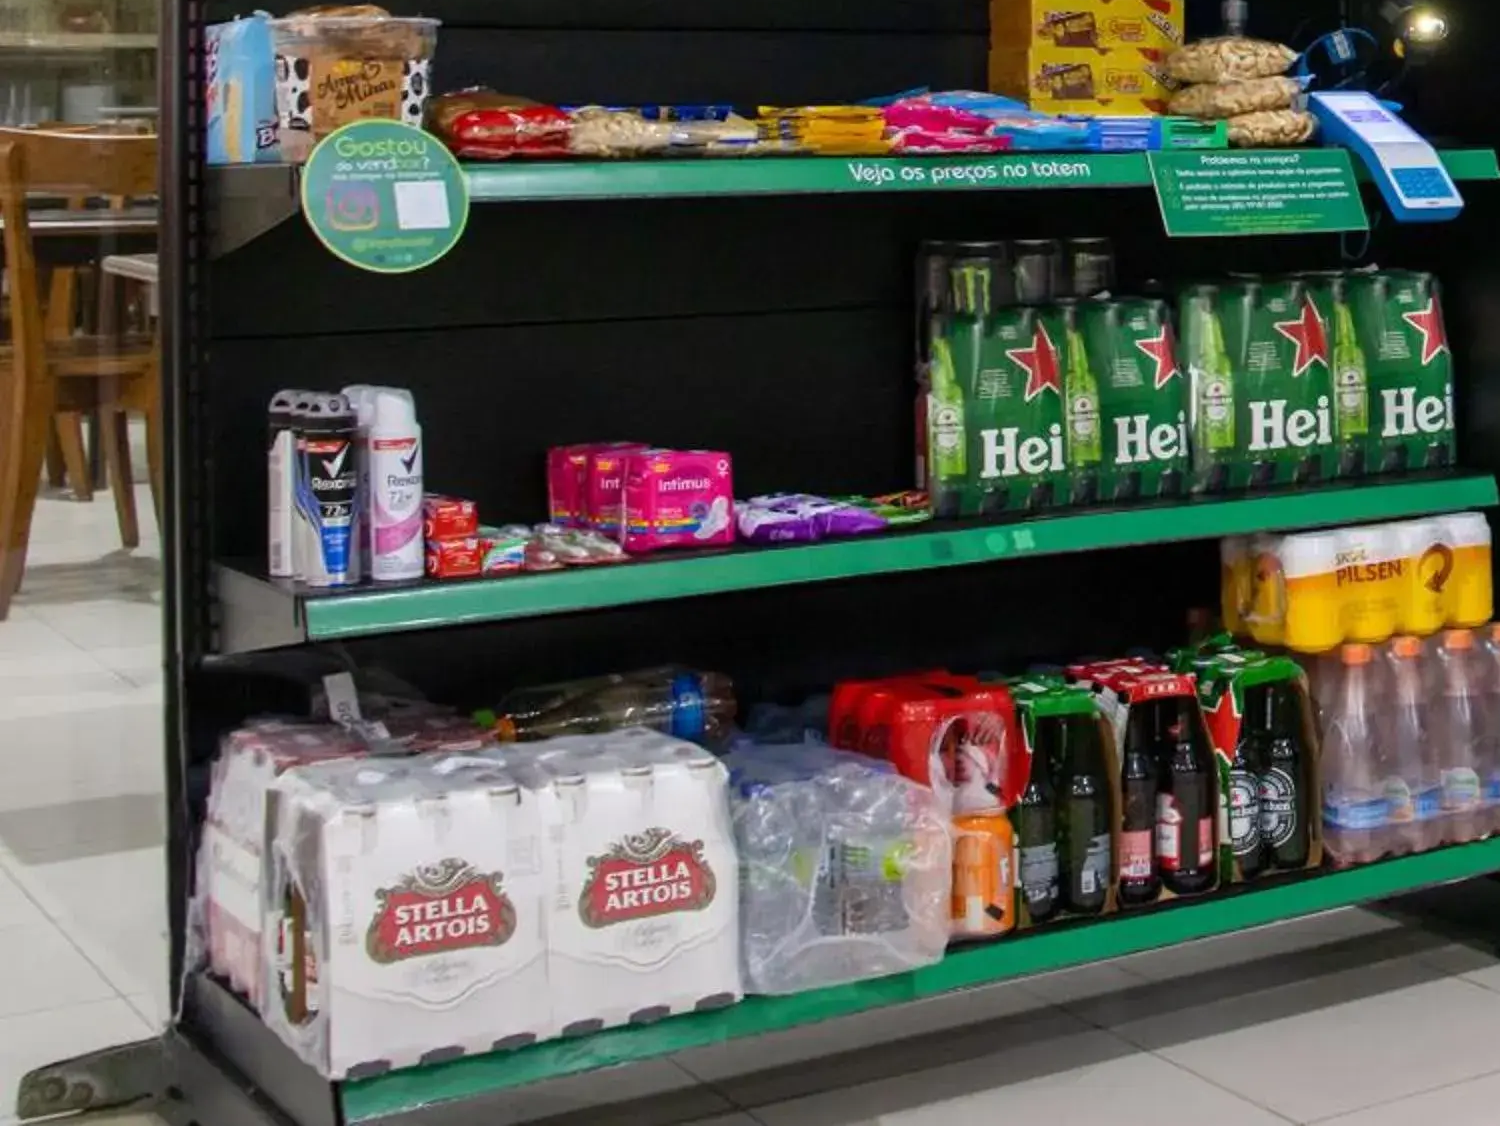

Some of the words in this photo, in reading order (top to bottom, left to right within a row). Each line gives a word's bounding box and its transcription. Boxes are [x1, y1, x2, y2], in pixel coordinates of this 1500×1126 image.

[334, 137, 428, 158] Gostou
[848, 163, 895, 185] Veja
[901, 165, 925, 181] os
[931, 164, 996, 184] preços
[1003, 165, 1027, 178] no
[1033, 161, 1091, 178] totem
[1248, 395, 1332, 451] Hei
[1381, 384, 1455, 438] Hei
[980, 423, 1065, 479] Hei
[1114, 410, 1188, 465] Hei
[658, 476, 711, 492] Intimus
[1336, 559, 1402, 587] PILSEN
[605, 861, 691, 891] STELLA
[394, 894, 490, 925] STELLA
[604, 882, 691, 912] ARTOIS
[394, 914, 490, 947] ARTOIS
